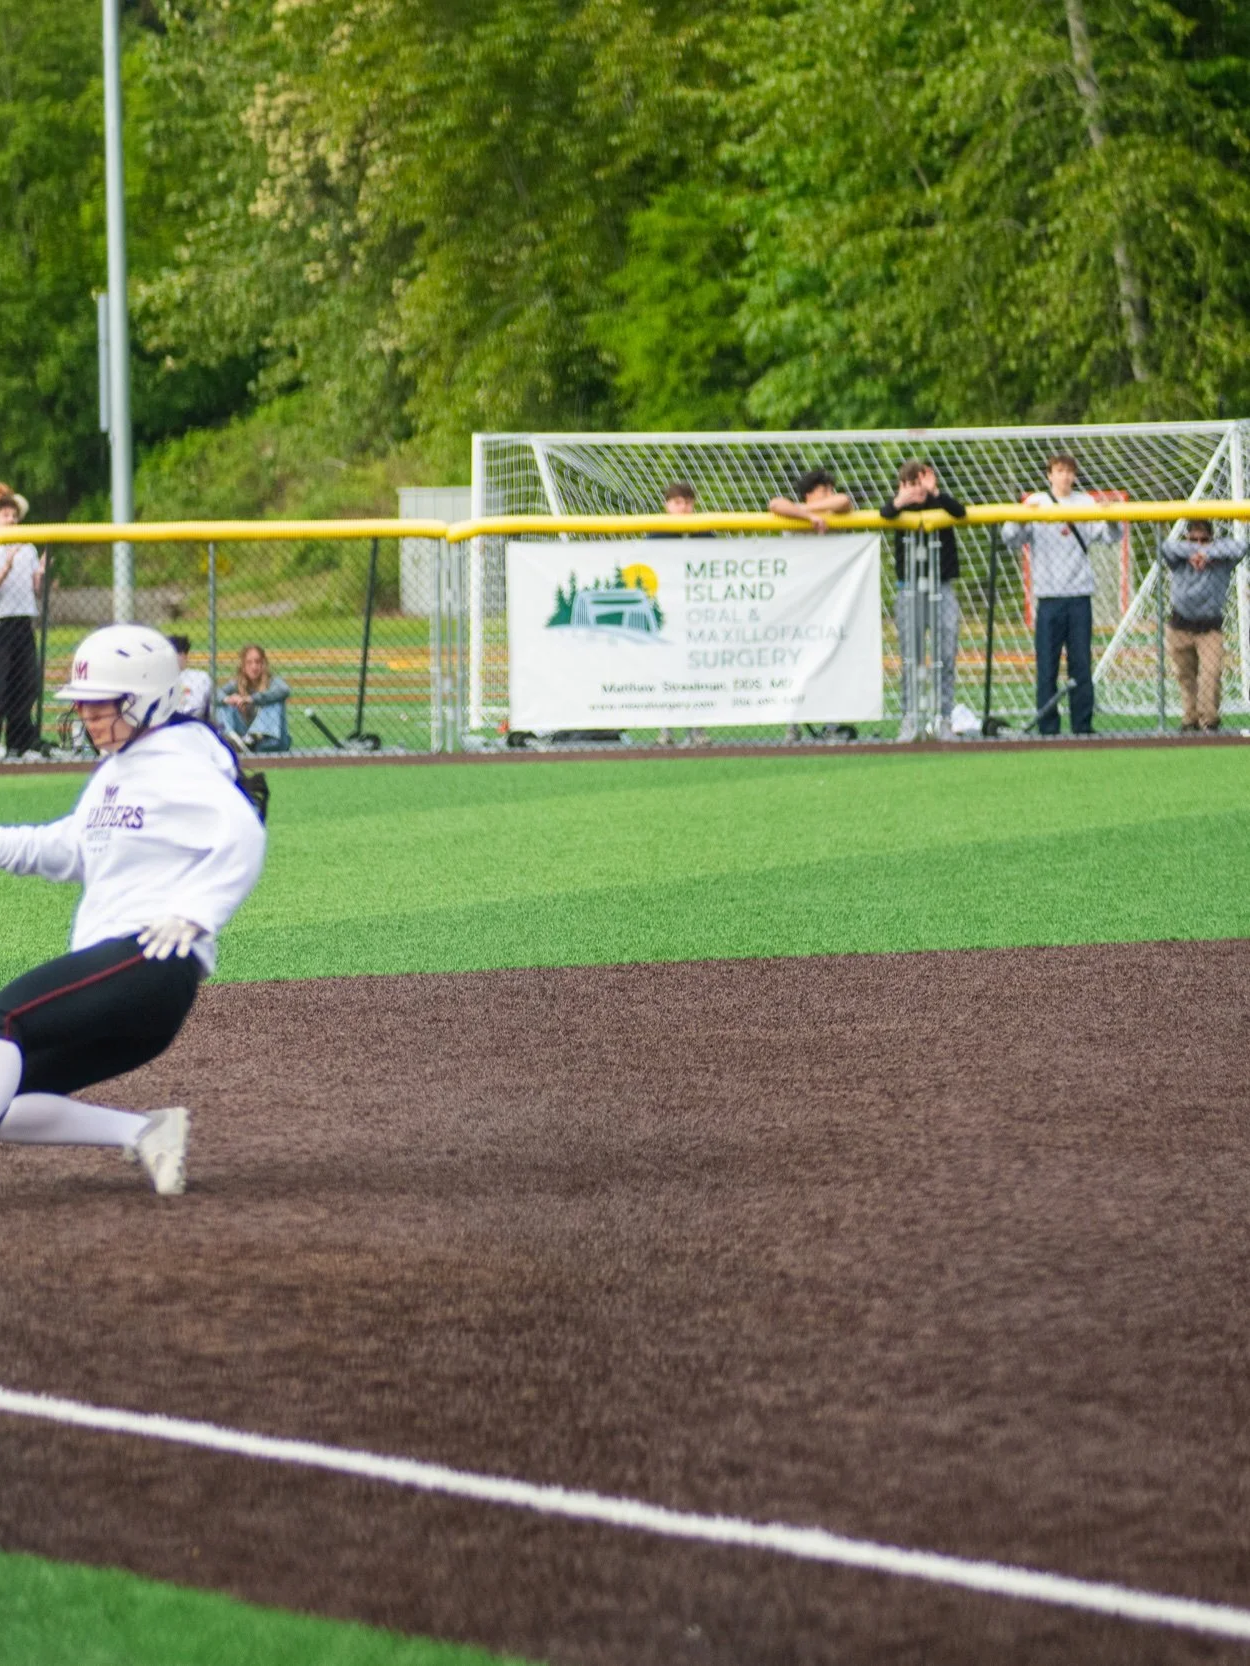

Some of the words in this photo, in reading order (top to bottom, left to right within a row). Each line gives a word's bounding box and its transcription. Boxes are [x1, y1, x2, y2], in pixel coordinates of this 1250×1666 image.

[685, 559, 788, 579] MERCER
[685, 582, 776, 603] ISLAND
[686, 607, 743, 625] ORAL
[747, 608, 761, 622] &
[686, 624, 849, 644] MAXILLOFACIAL
[687, 648, 803, 670] SURGERY
